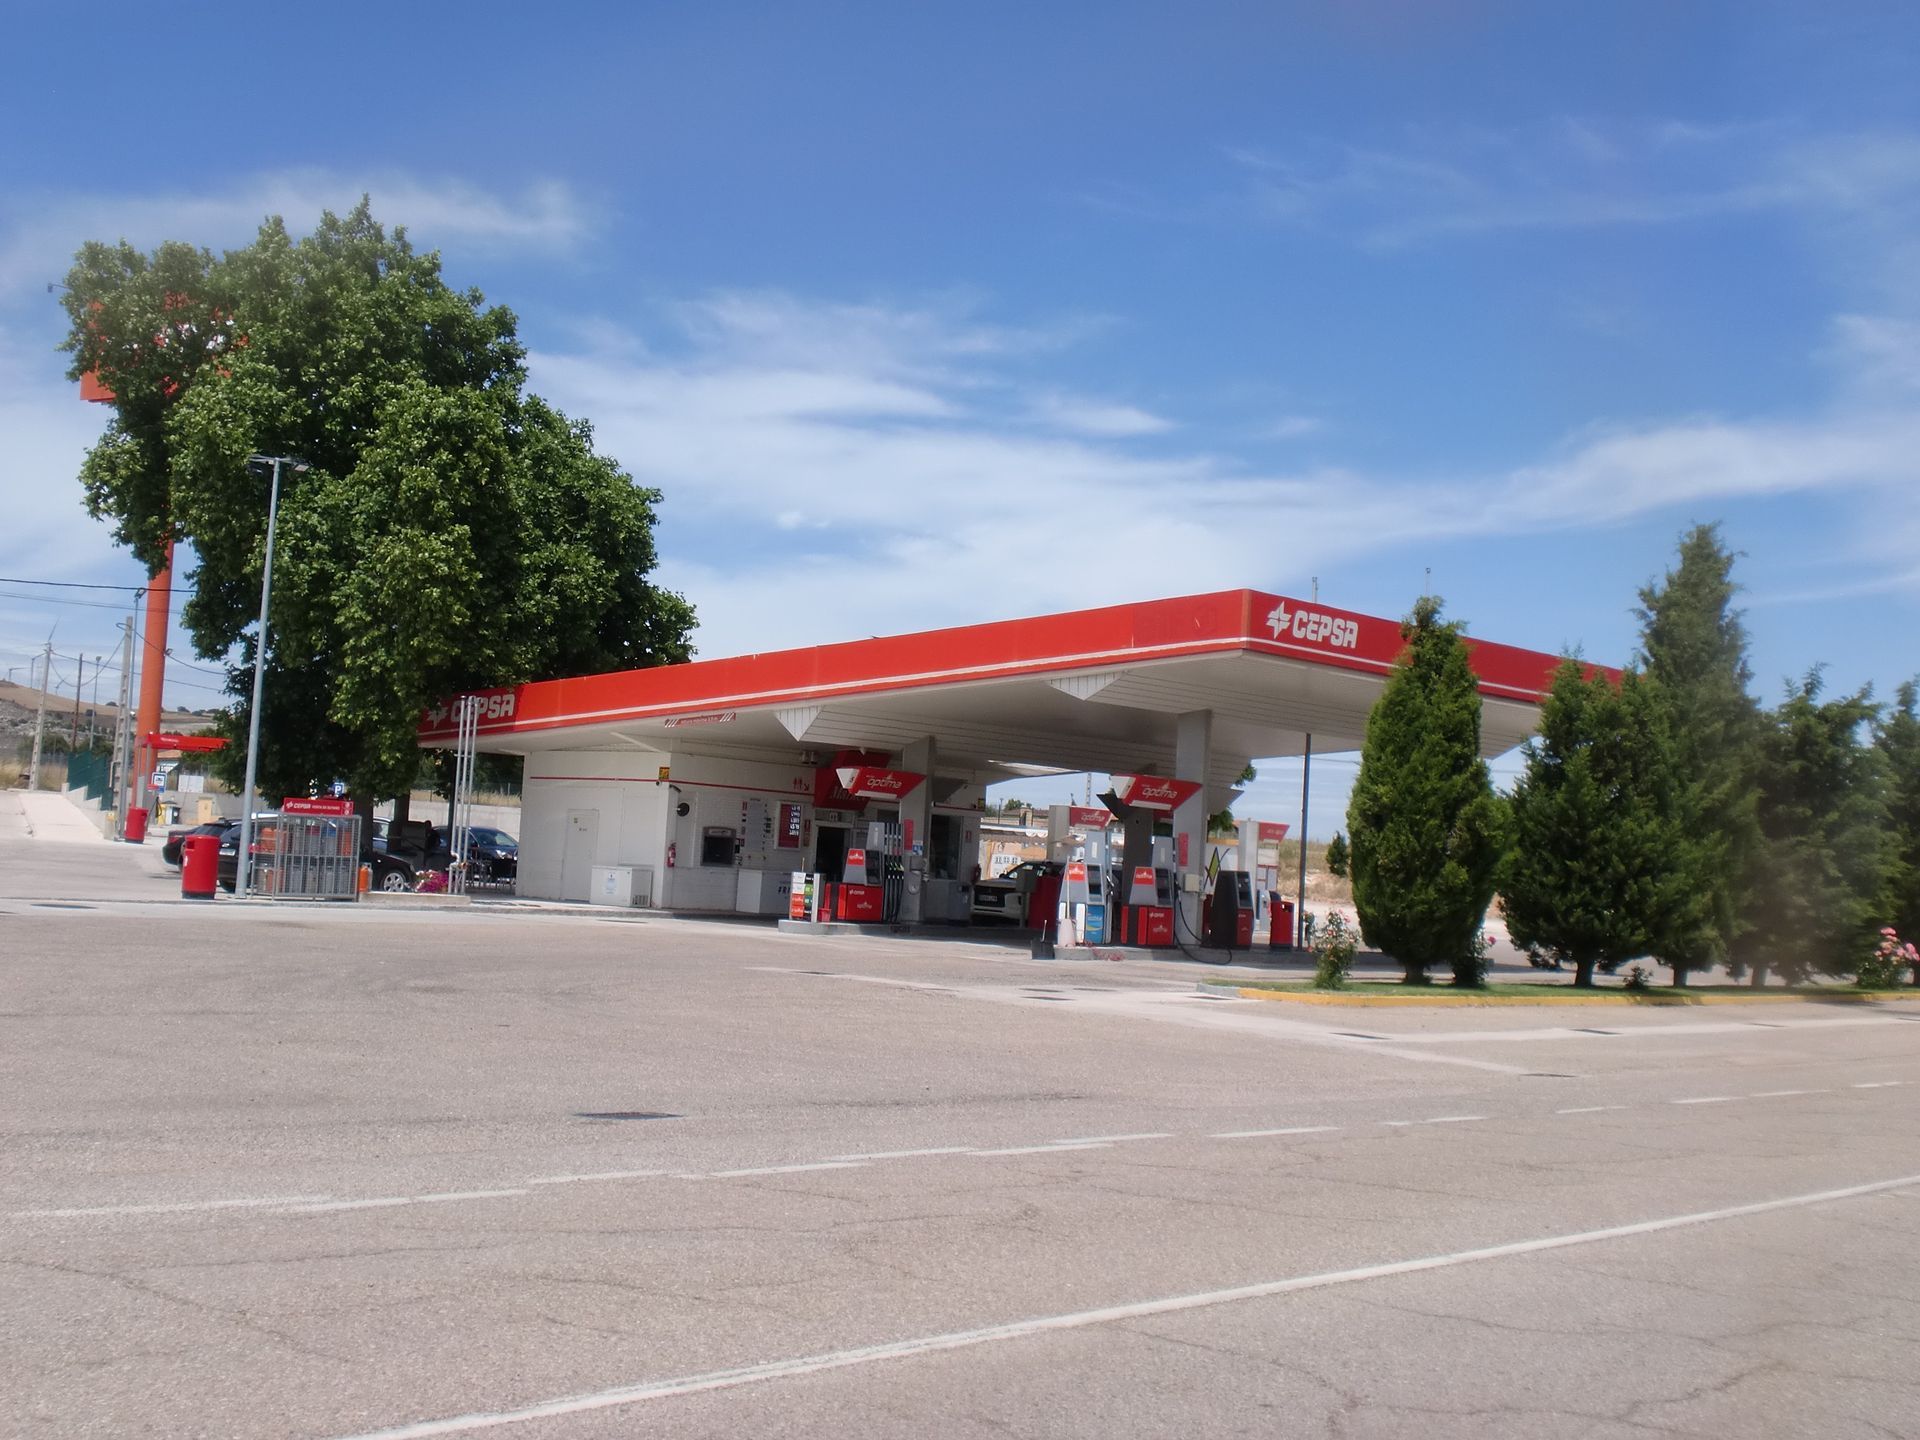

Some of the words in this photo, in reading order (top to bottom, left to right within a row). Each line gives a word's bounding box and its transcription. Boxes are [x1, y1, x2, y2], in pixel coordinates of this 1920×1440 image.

[1293, 610, 1358, 649] CEPSA
[867, 773, 902, 789] optima
[334, 785, 342, 794] P
[1142, 782, 1178, 799] optima
